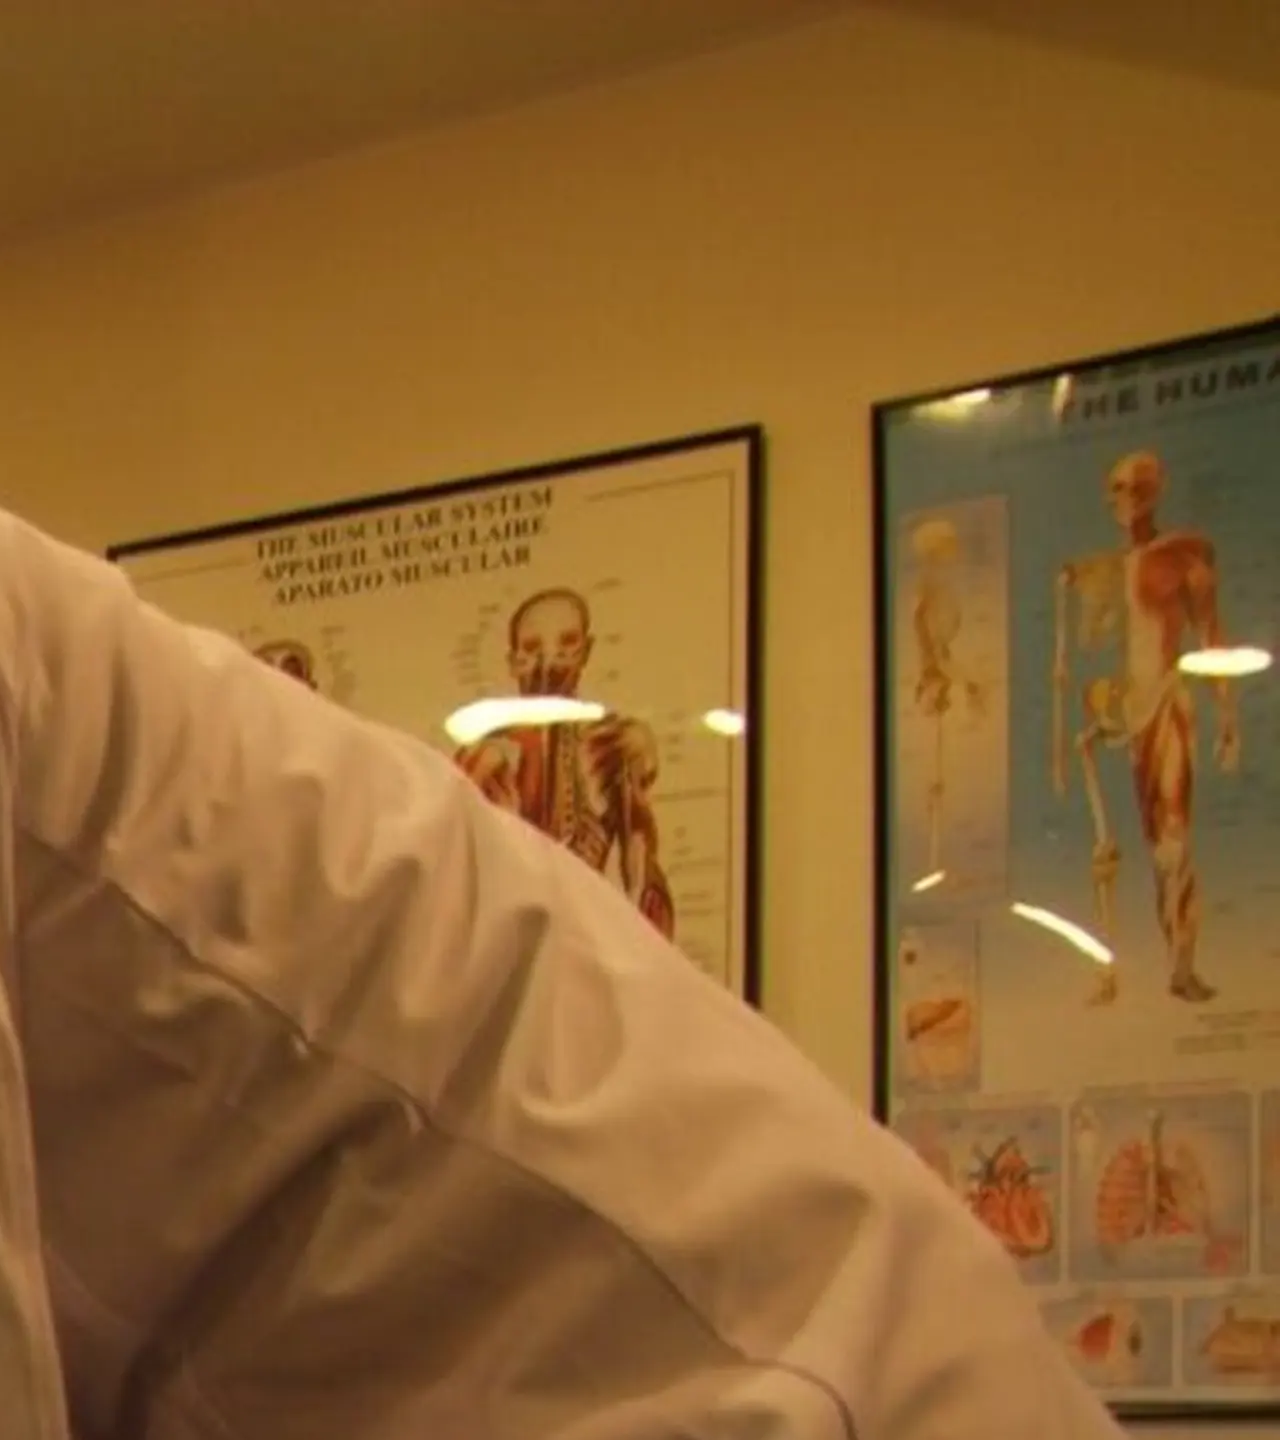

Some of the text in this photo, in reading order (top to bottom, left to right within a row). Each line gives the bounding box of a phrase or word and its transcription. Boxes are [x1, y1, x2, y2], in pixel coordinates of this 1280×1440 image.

[256, 486, 554, 560] THE MUSCULAR SYSTEM
[272, 545, 533, 608] APARATO MUSCULAR
